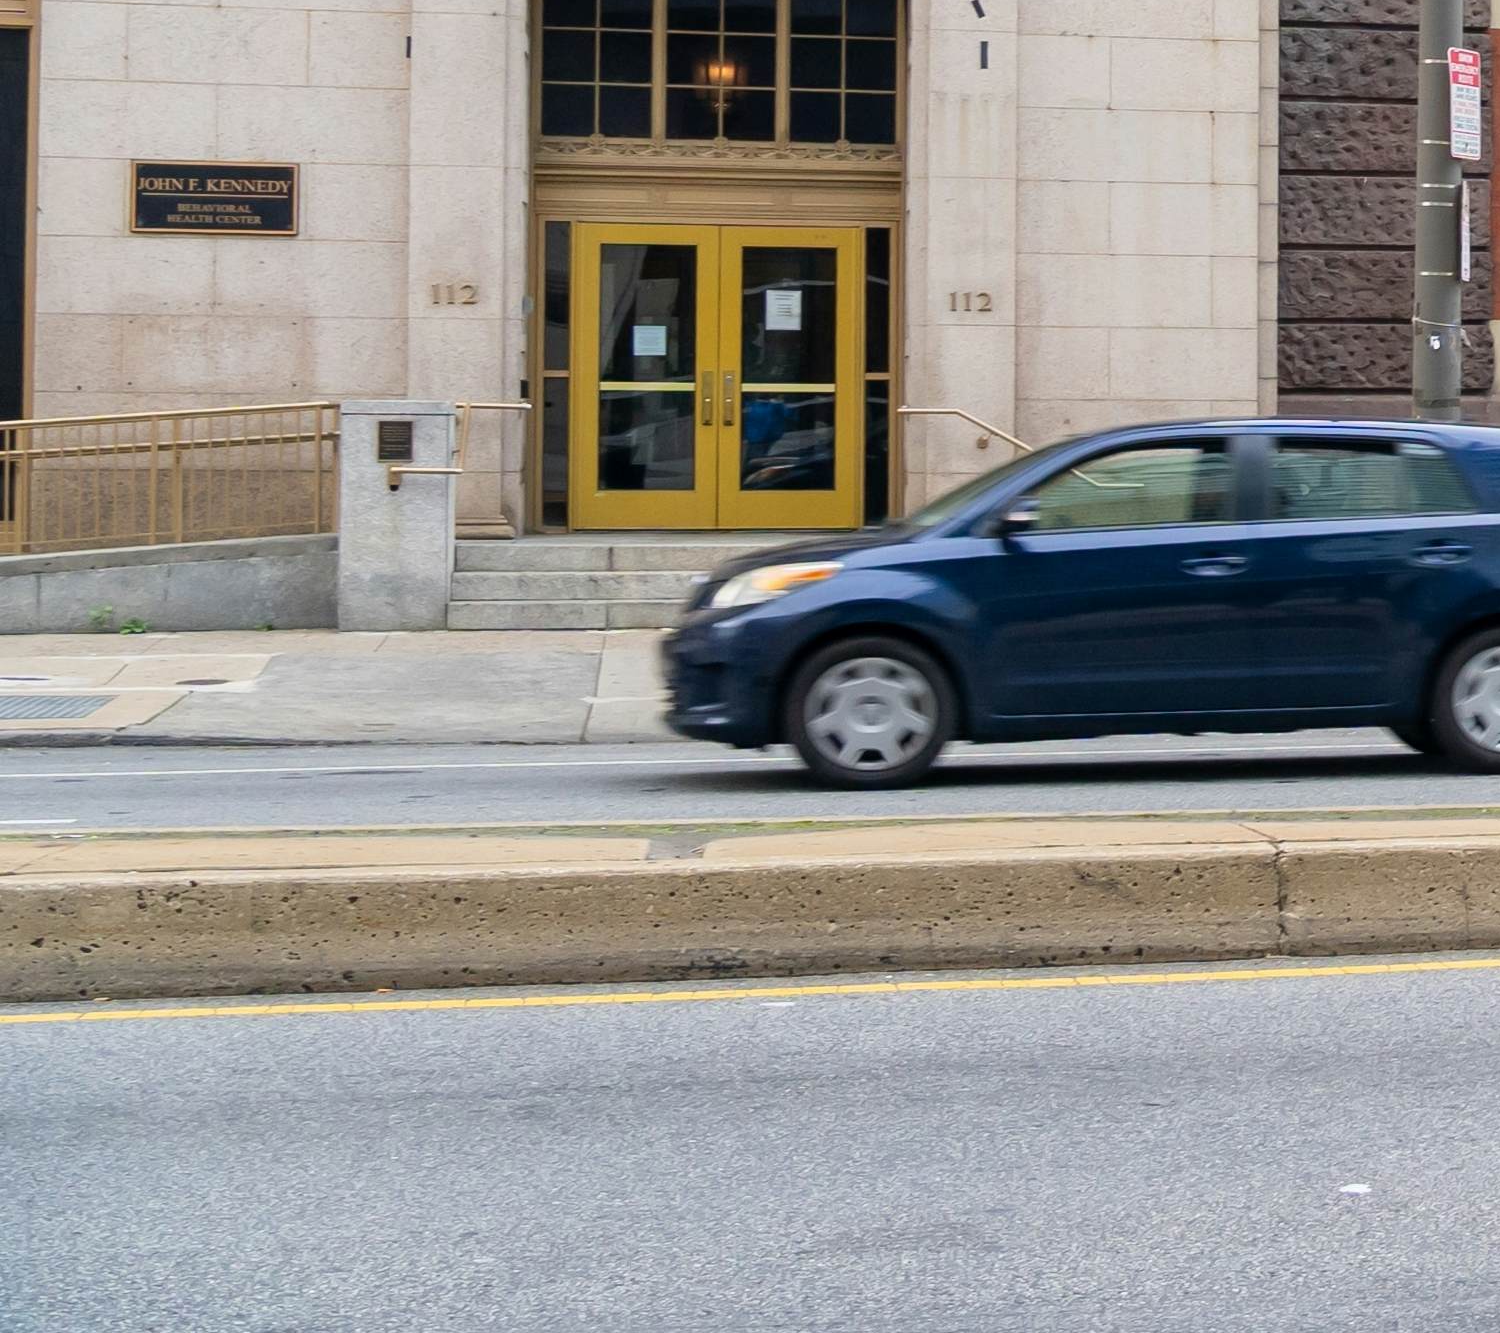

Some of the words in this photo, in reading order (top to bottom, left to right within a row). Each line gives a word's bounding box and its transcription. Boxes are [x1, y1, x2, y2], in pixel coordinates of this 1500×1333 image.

[138, 177, 184, 190] JOHN
[189, 179, 203, 191] F.
[206, 179, 292, 194] KENNEDY
[177, 203, 253, 213] BEHAVIORAL
[167, 214, 213, 223] HEALTH
[216, 215, 262, 225] CENTER
[431, 283, 480, 305] 112
[949, 291, 992, 312] 112
